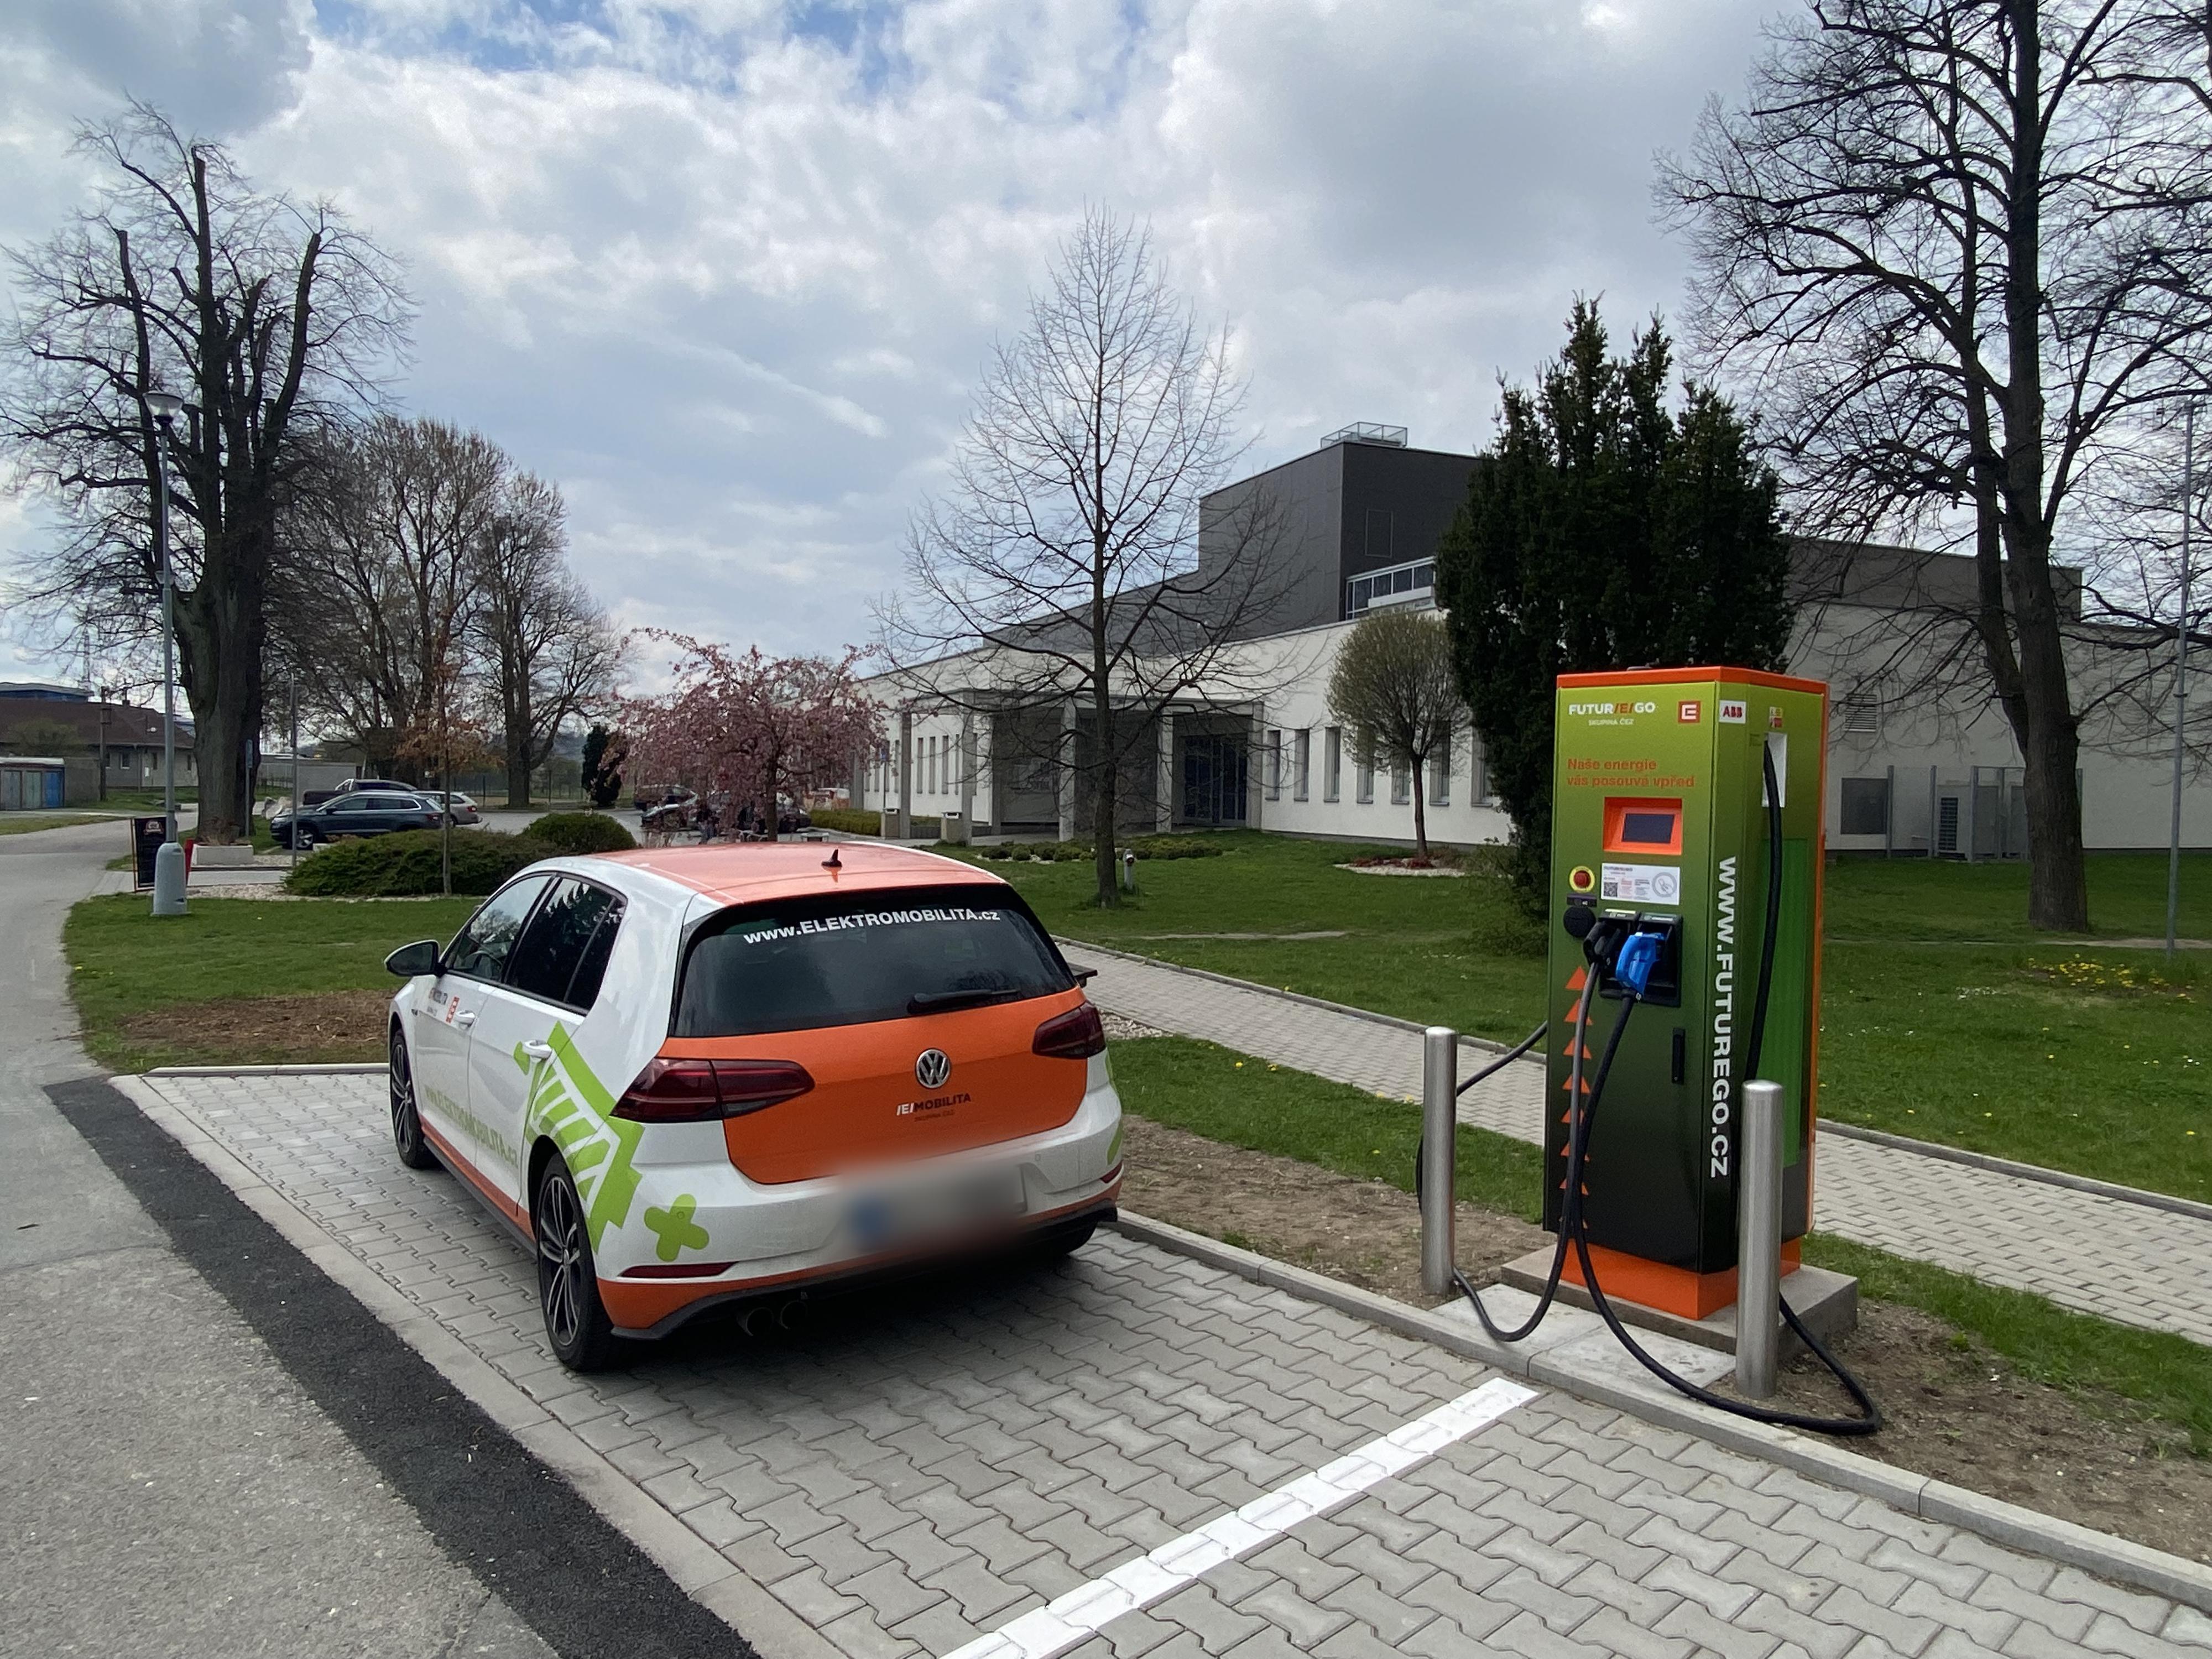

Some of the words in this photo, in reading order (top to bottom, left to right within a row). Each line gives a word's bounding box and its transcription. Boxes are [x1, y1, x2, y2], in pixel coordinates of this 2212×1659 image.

[1723, 706, 1743, 718] ABB
[1568, 758, 1600, 770] Naše
[1604, 759, 1657, 772] energie
[743, 909, 1000, 943] www.ELEKTROMOBILITA.cz
[1710, 857, 1736, 1178] WWW.FUTUREGO.CZ
